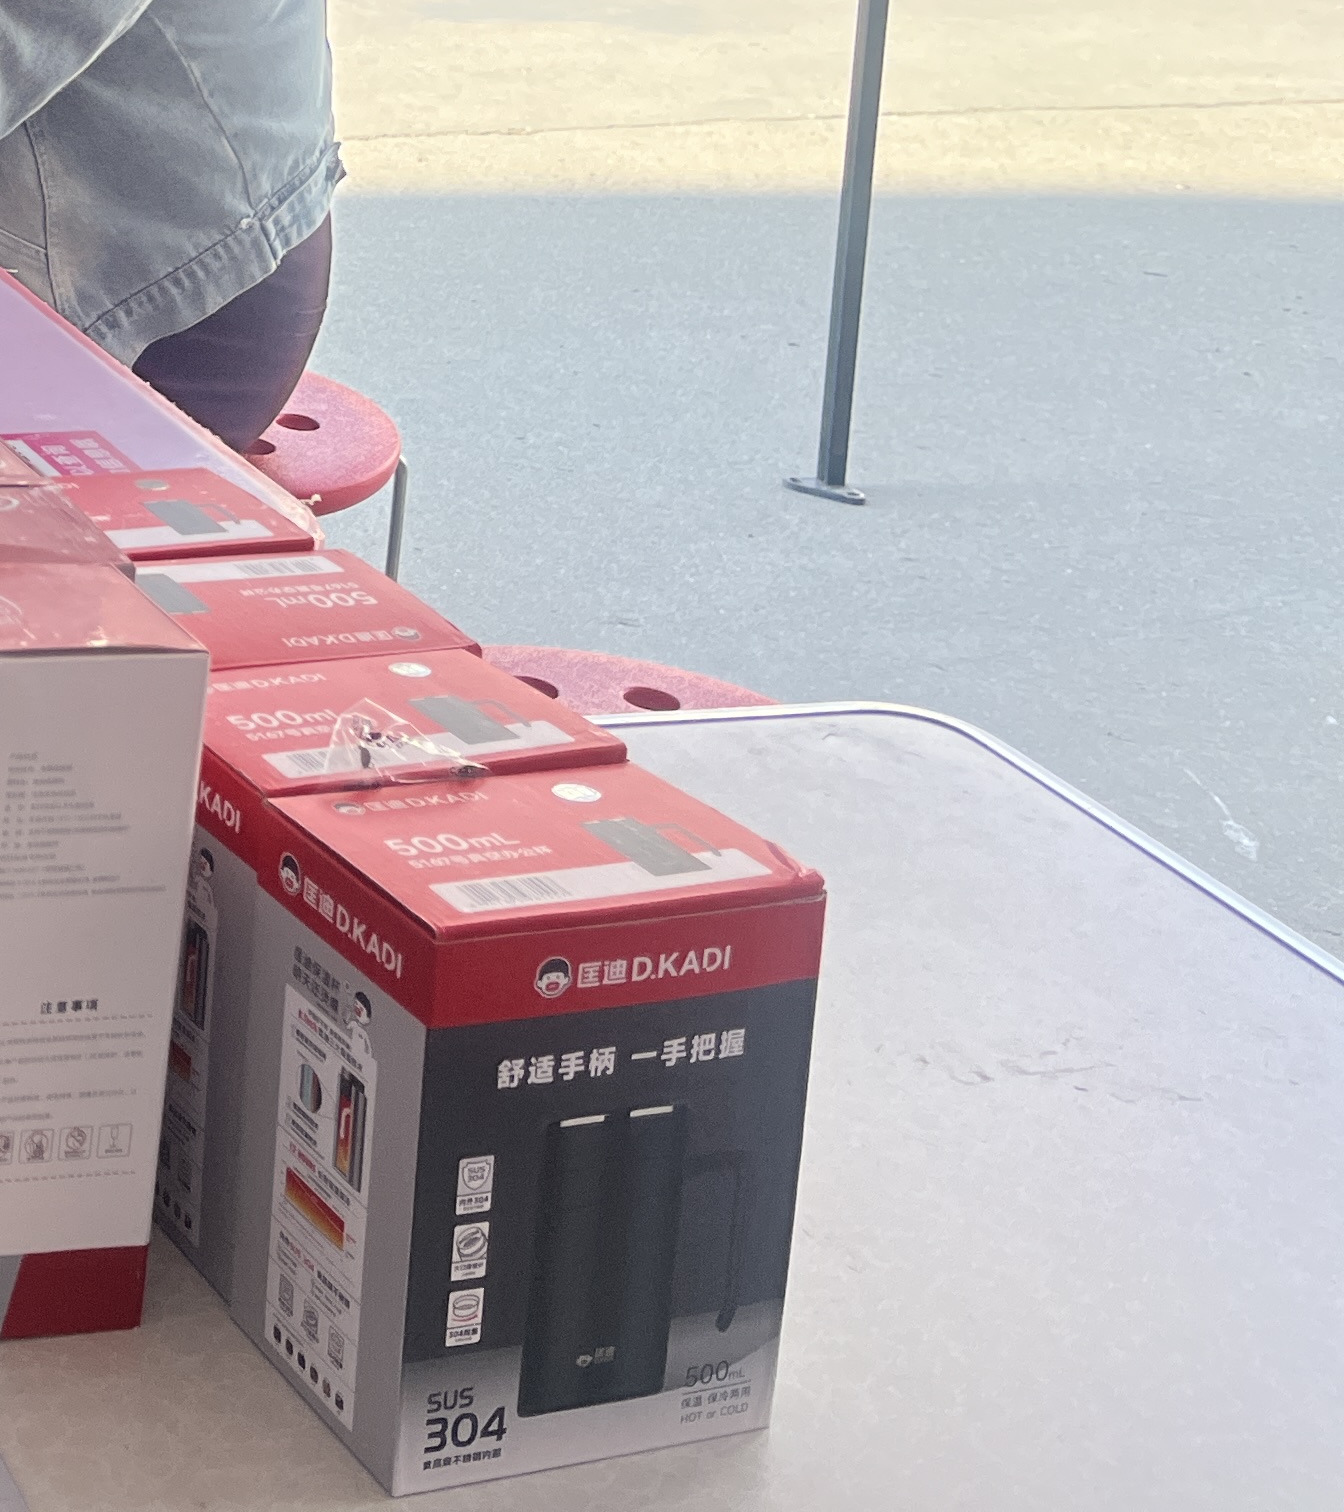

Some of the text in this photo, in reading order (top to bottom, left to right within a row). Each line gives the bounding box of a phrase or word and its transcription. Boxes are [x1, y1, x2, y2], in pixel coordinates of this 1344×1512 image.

[264, 590, 379, 609] 500mL
[385, 831, 521, 857] 500mL
[40, 999, 99, 1015] 注意事项
[496, 1029, 746, 1090] 舒适手柄 一手把握
[685, 1359, 746, 1387] 500mL
[427, 1388, 474, 1414] SUS
[680, 1393, 703, 1409] 保温
[680, 1401, 749, 1425] HOT or COLD
[423, 1406, 507, 1454] 304
